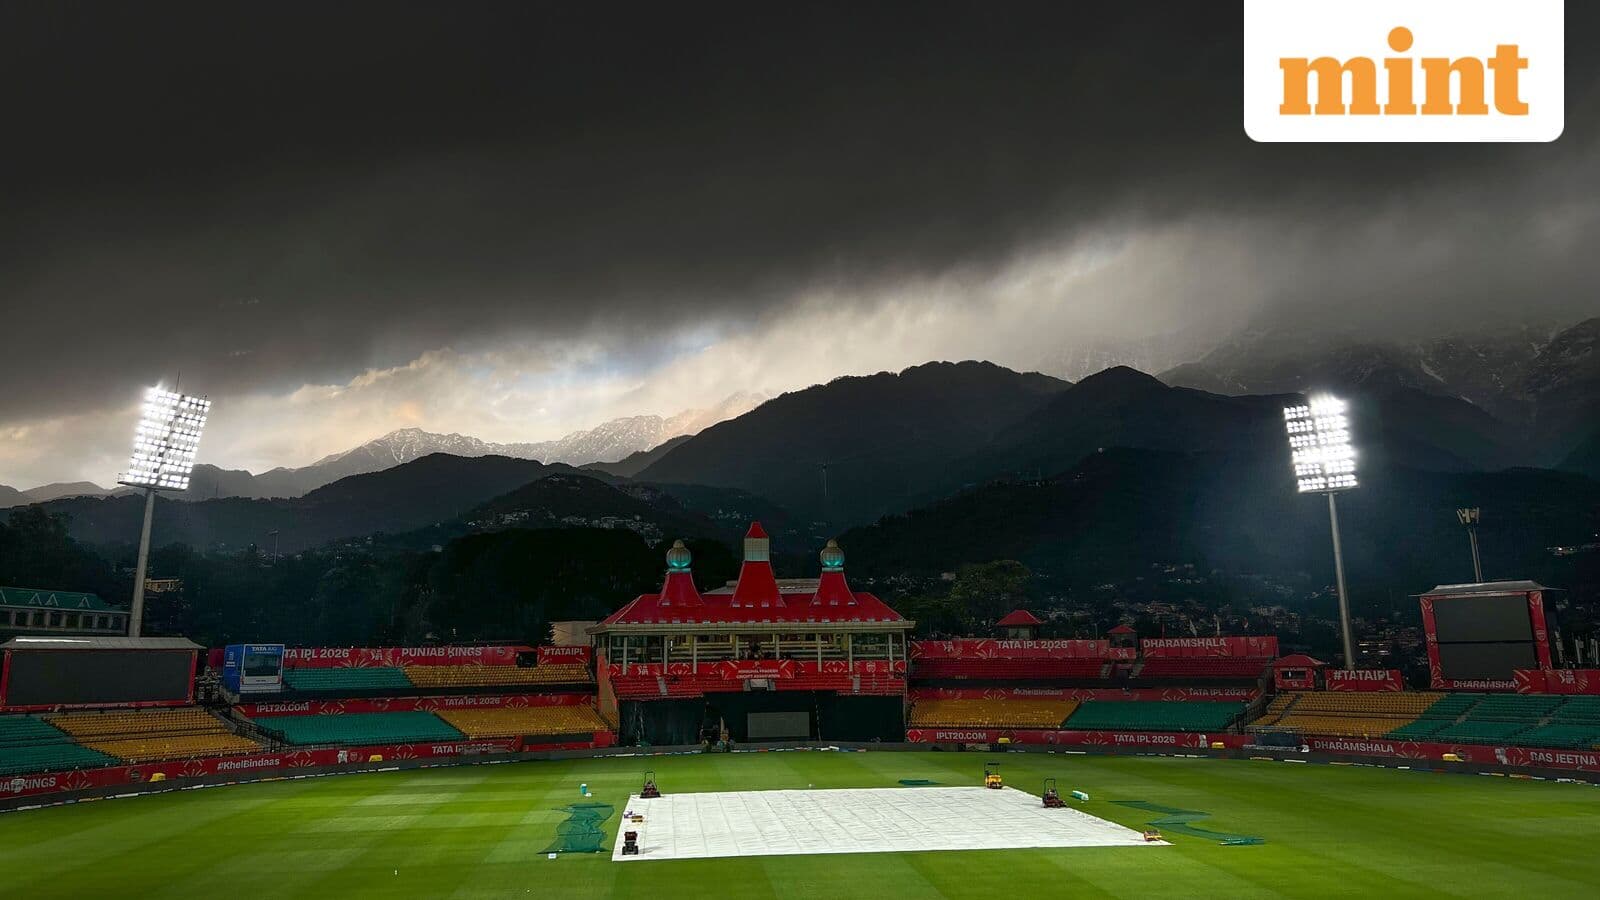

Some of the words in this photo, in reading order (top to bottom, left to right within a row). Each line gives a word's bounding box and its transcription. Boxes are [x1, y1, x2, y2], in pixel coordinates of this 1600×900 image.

[997, 640, 1021, 650] TATA
[1024, 640, 1040, 649] IPL
[1041, 640, 1068, 650] 2026
[1143, 638, 1226, 648] DHARAMSHALA
[300, 649, 318, 658] IPL
[319, 648, 350, 658] 2026
[401, 648, 445, 656] PUNJAB
[447, 647, 482, 656] KINGS
[1333, 670, 1394, 681] #TATAIPL
[256, 702, 310, 712] IPLT20.COM
[1113, 734, 1134, 743] TATA
[1136, 735, 1151, 744] IPL
[1152, 736, 1176, 744] 2026
[432, 746, 453, 754] TATA
[1314, 740, 1394, 752] DHARAMSHALA
[217, 758, 280, 770] #KhelBindaas
[1556, 754, 1597, 765] JEETNA
[22, 777, 56, 790] KINGS
